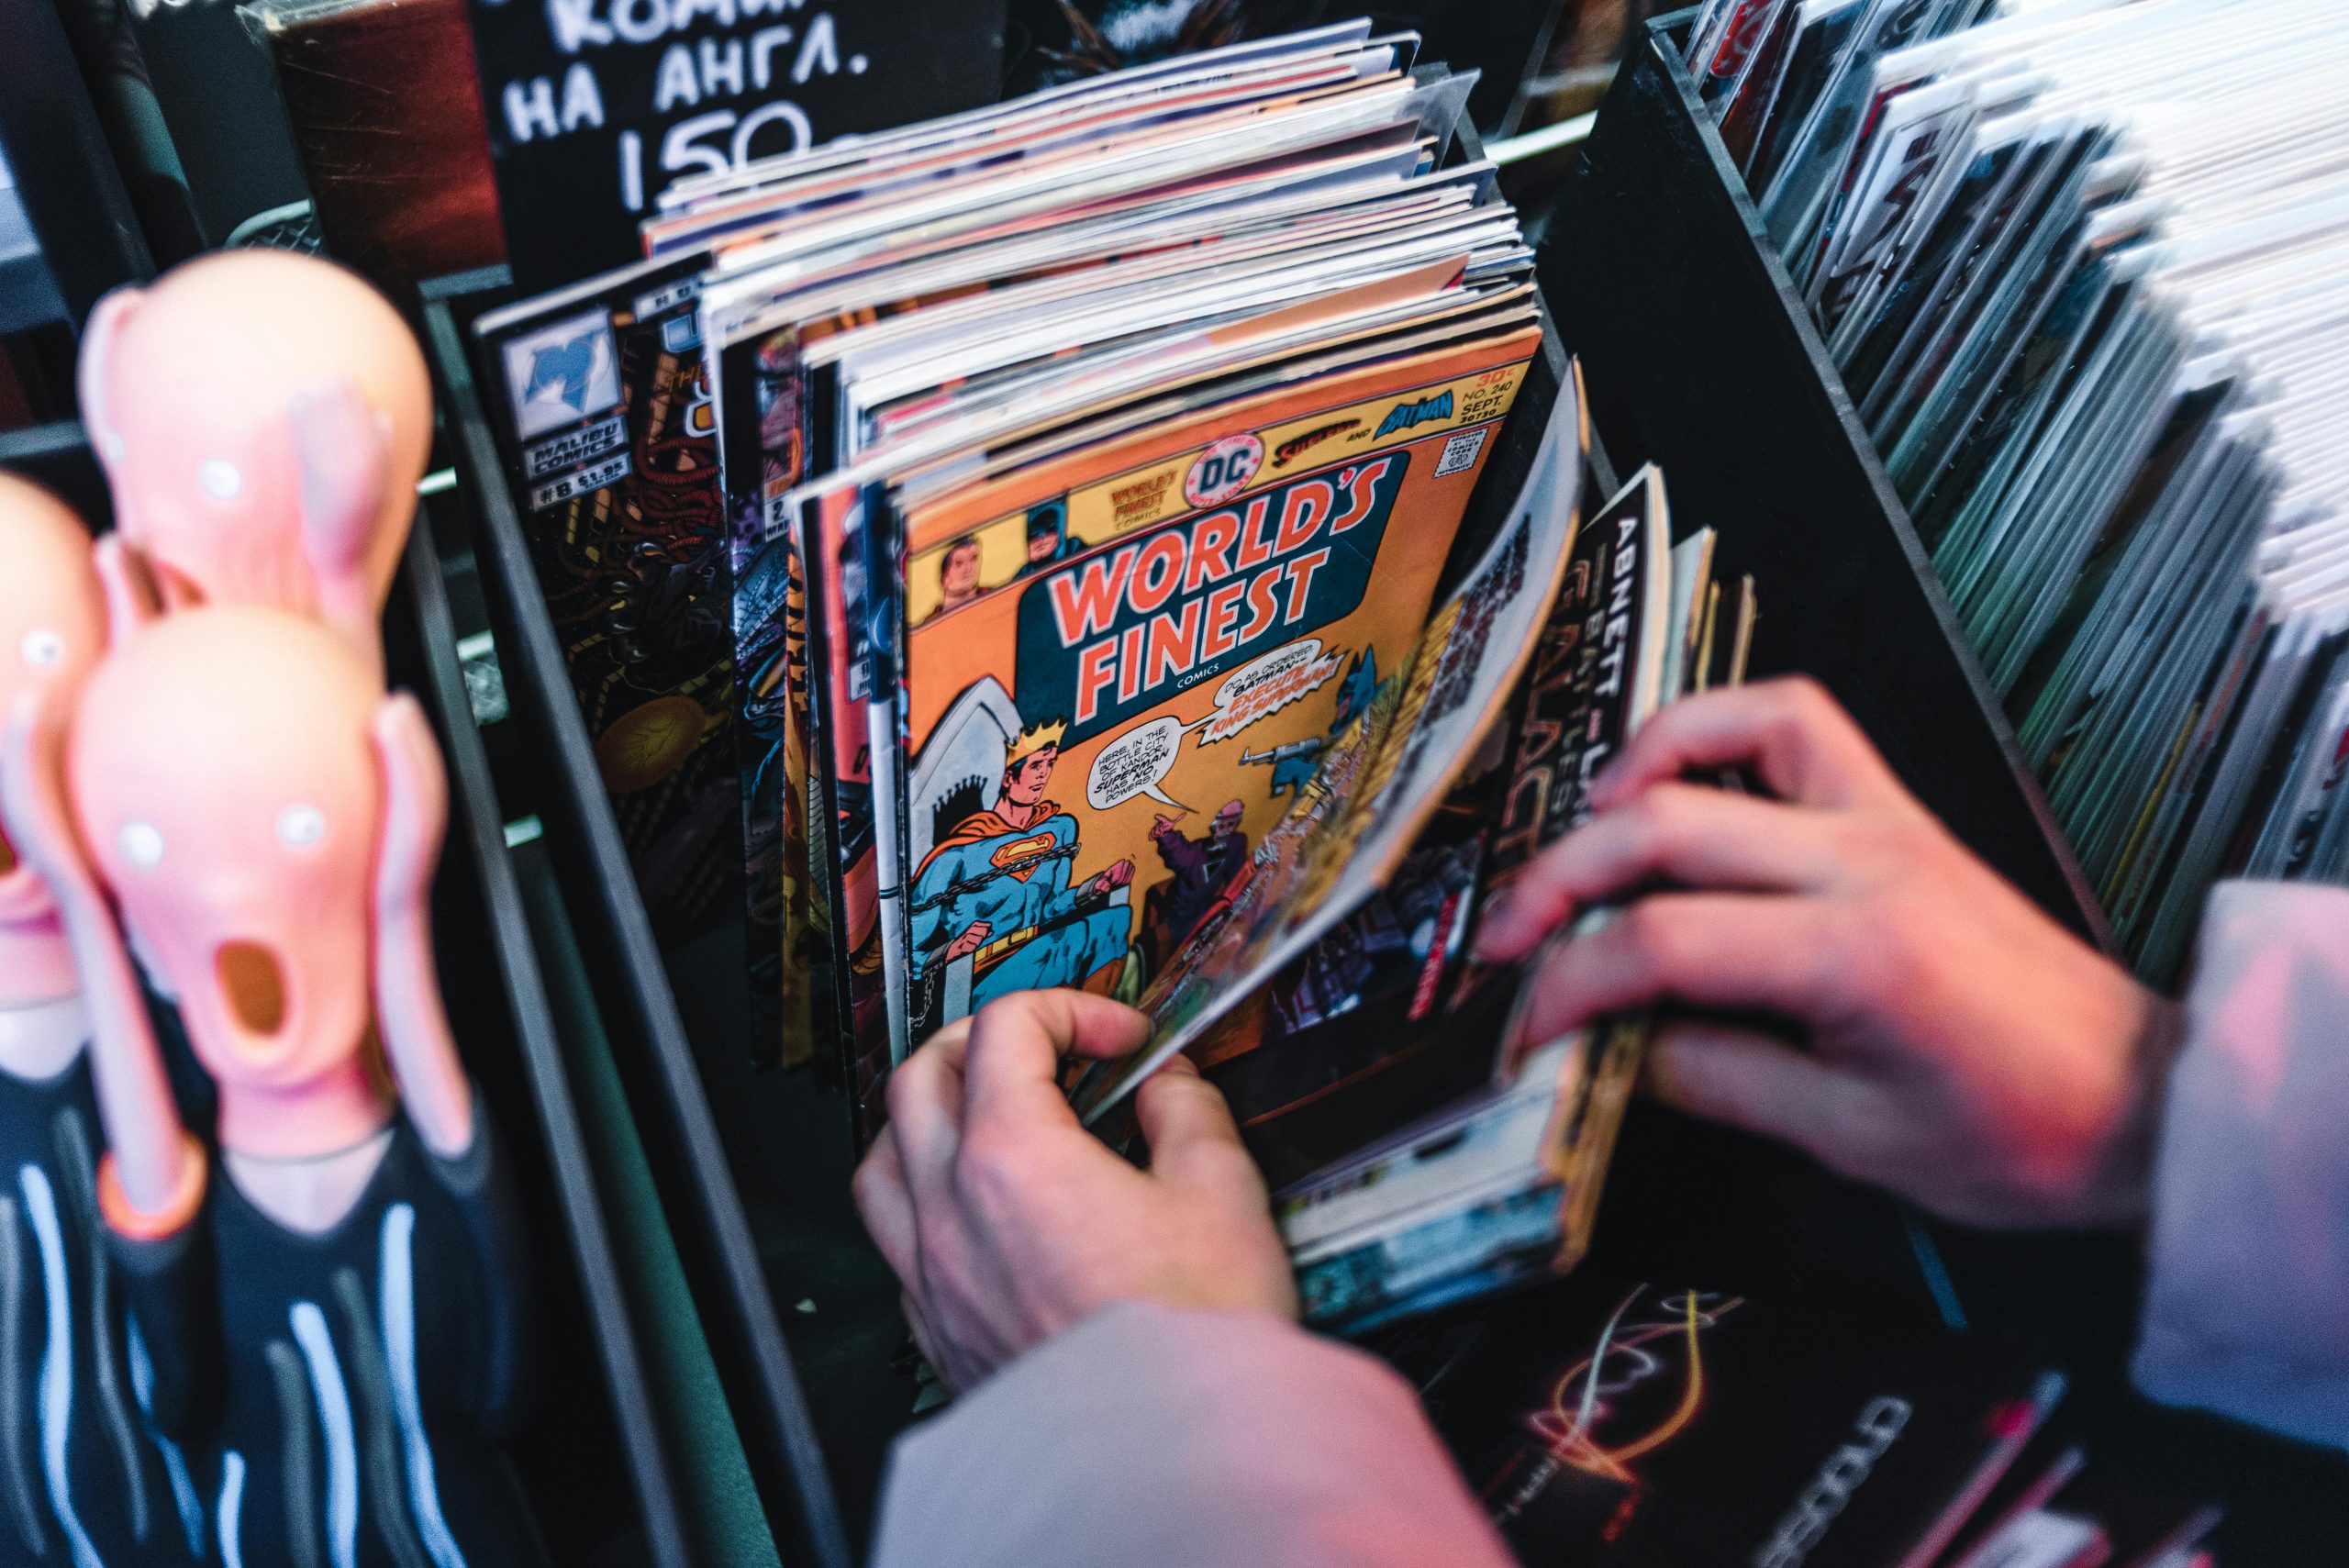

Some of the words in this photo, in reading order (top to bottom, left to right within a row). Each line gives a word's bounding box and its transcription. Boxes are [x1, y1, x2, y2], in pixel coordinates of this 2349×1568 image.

[503, 61, 606, 142] НА
[1461, 395, 1503, 416] SEPT.
[1462, 388, 1486, 403] NO.
[1490, 380, 1513, 394] 240
[1375, 389, 1454, 440] BATMAN
[534, 422, 619, 462] MALIBU
[534, 435, 617, 474] COMICS
[1198, 449, 1251, 495] DC
[1047, 457, 1392, 648] WORLD'S
[1594, 517, 1639, 697] ABNETT
[1074, 546, 1332, 726] FINEST
[1175, 662, 1220, 689] COMICS
[1224, 678, 1243, 694] DO
[1245, 671, 1260, 681] AS
[1229, 662, 1308, 714] EXECUTE
[1210, 705, 1251, 737] KING
[1098, 745, 1130, 767] HERE,
[1132, 738, 1143, 750] IN
[1145, 725, 1167, 740] THE
[1099, 747, 1142, 775] BOTTLE
[1144, 732, 1169, 751] CITY
[1094, 748, 1170, 795] SUPERMAN
[1101, 767, 1118, 782] OF
[1105, 769, 1159, 804] POWERS!
[1106, 779, 1129, 795] HAS
[1133, 765, 1154, 782] NO
